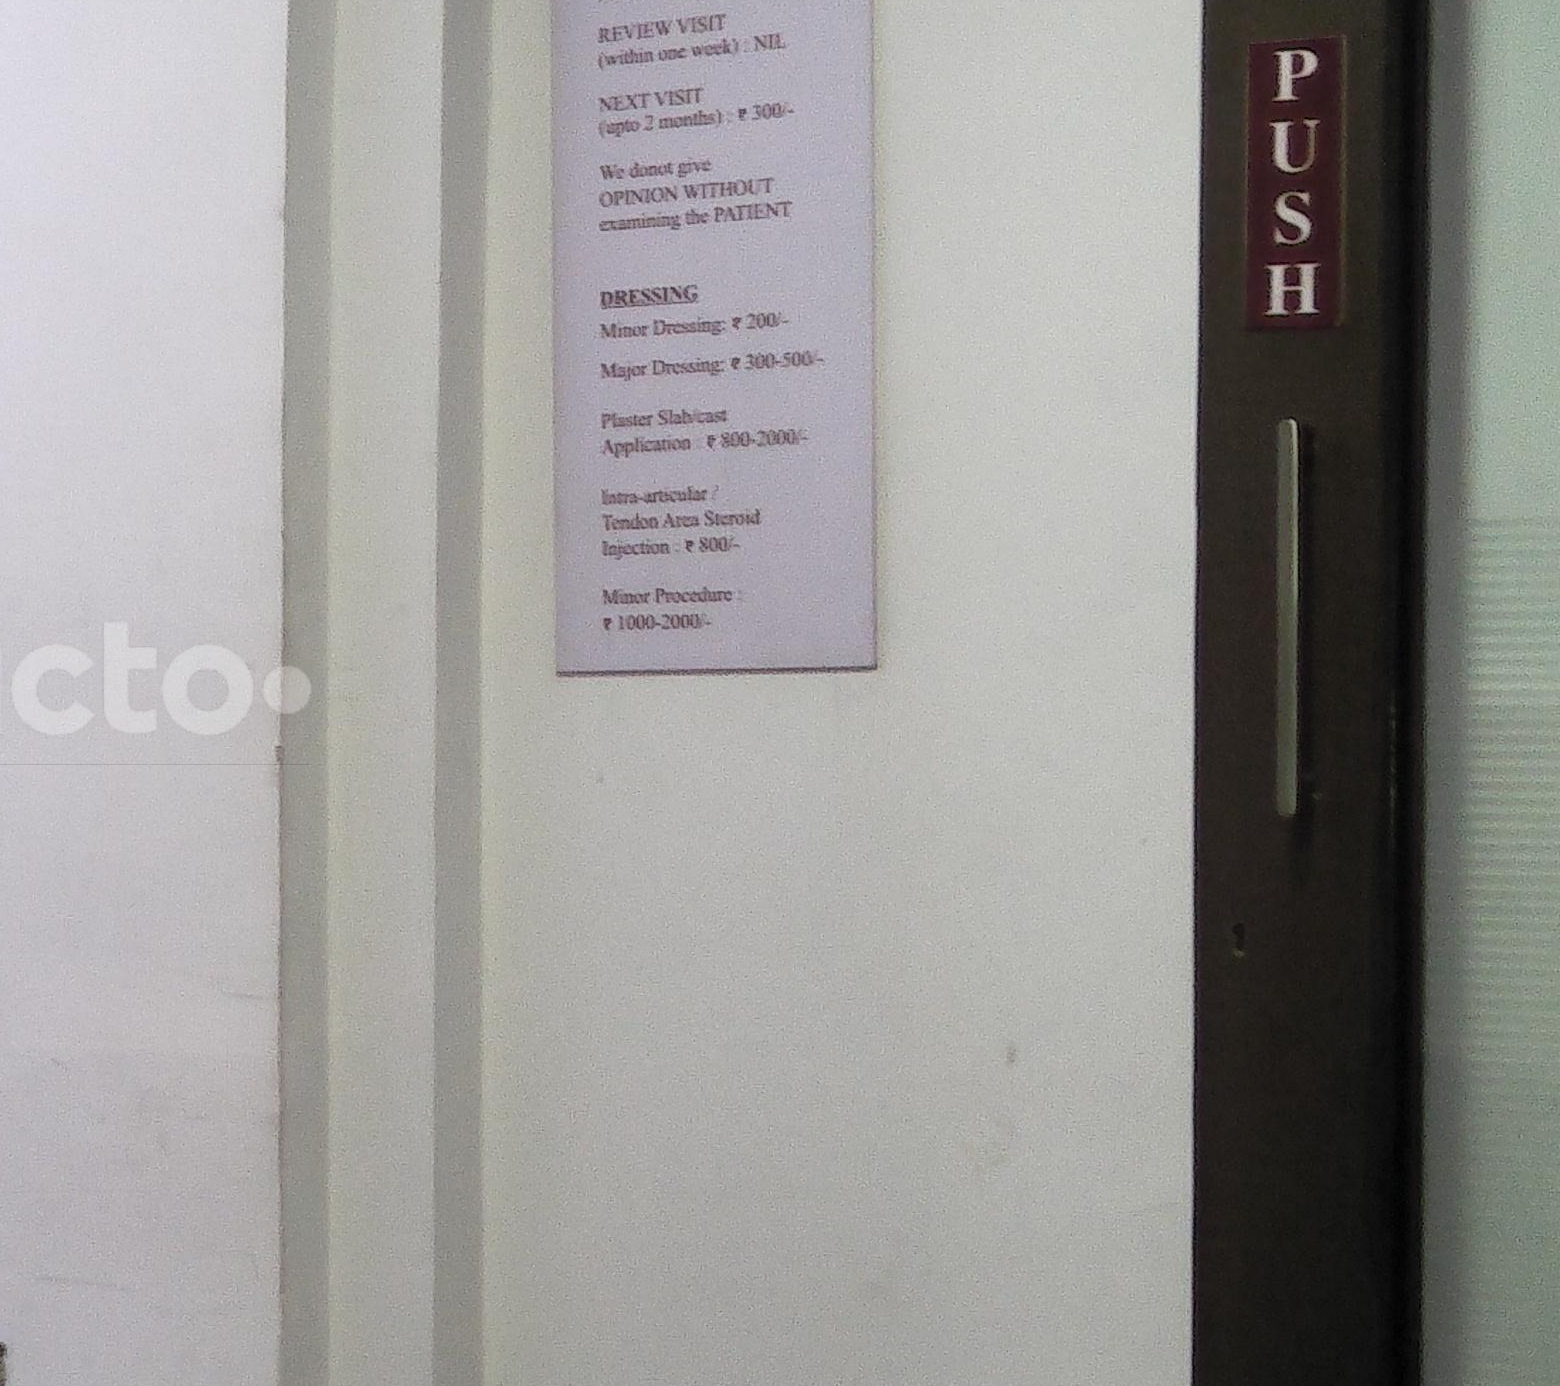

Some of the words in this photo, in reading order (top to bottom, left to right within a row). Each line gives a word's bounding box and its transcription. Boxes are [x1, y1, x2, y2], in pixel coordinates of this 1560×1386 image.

[597, 19, 672, 44] REVIEW
[676, 13, 727, 34] VISIT
[598, 47, 654, 70] (within
[658, 47, 687, 62] one
[691, 37, 739, 58] week)
[754, 32, 787, 51] NIL
[598, 92, 652, 112] NEXT
[653, 87, 704, 107] VISIT
[598, 118, 640, 138] (upto
[643, 114, 654, 131] 2
[659, 109, 722, 129] months)
[600, 165, 625, 180] We
[630, 162, 673, 179] donot
[678, 159, 712, 179] give
[599, 185, 679, 207] OPINION
[683, 178, 775, 200] WITHOUT
[1264, 47, 1321, 316] PUSH
[599, 213, 681, 232] examining
[685, 209, 709, 226] the
[714, 201, 793, 223] PATIENT
[600, 284, 698, 309] DRESSING
[600, 322, 649, 339] Minor
[600, 362, 648, 381] Major
[601, 412, 654, 429] Plaster
[602, 436, 692, 459] Application
[601, 486, 708, 505] Intra-articular
[602, 513, 659, 531] Tendon
[663, 512, 700, 528] Area
[704, 508, 762, 526] Steroid
[602, 538, 671, 560] Injection
[602, 588, 650, 605] Minor
[655, 587, 733, 604] Procedure
